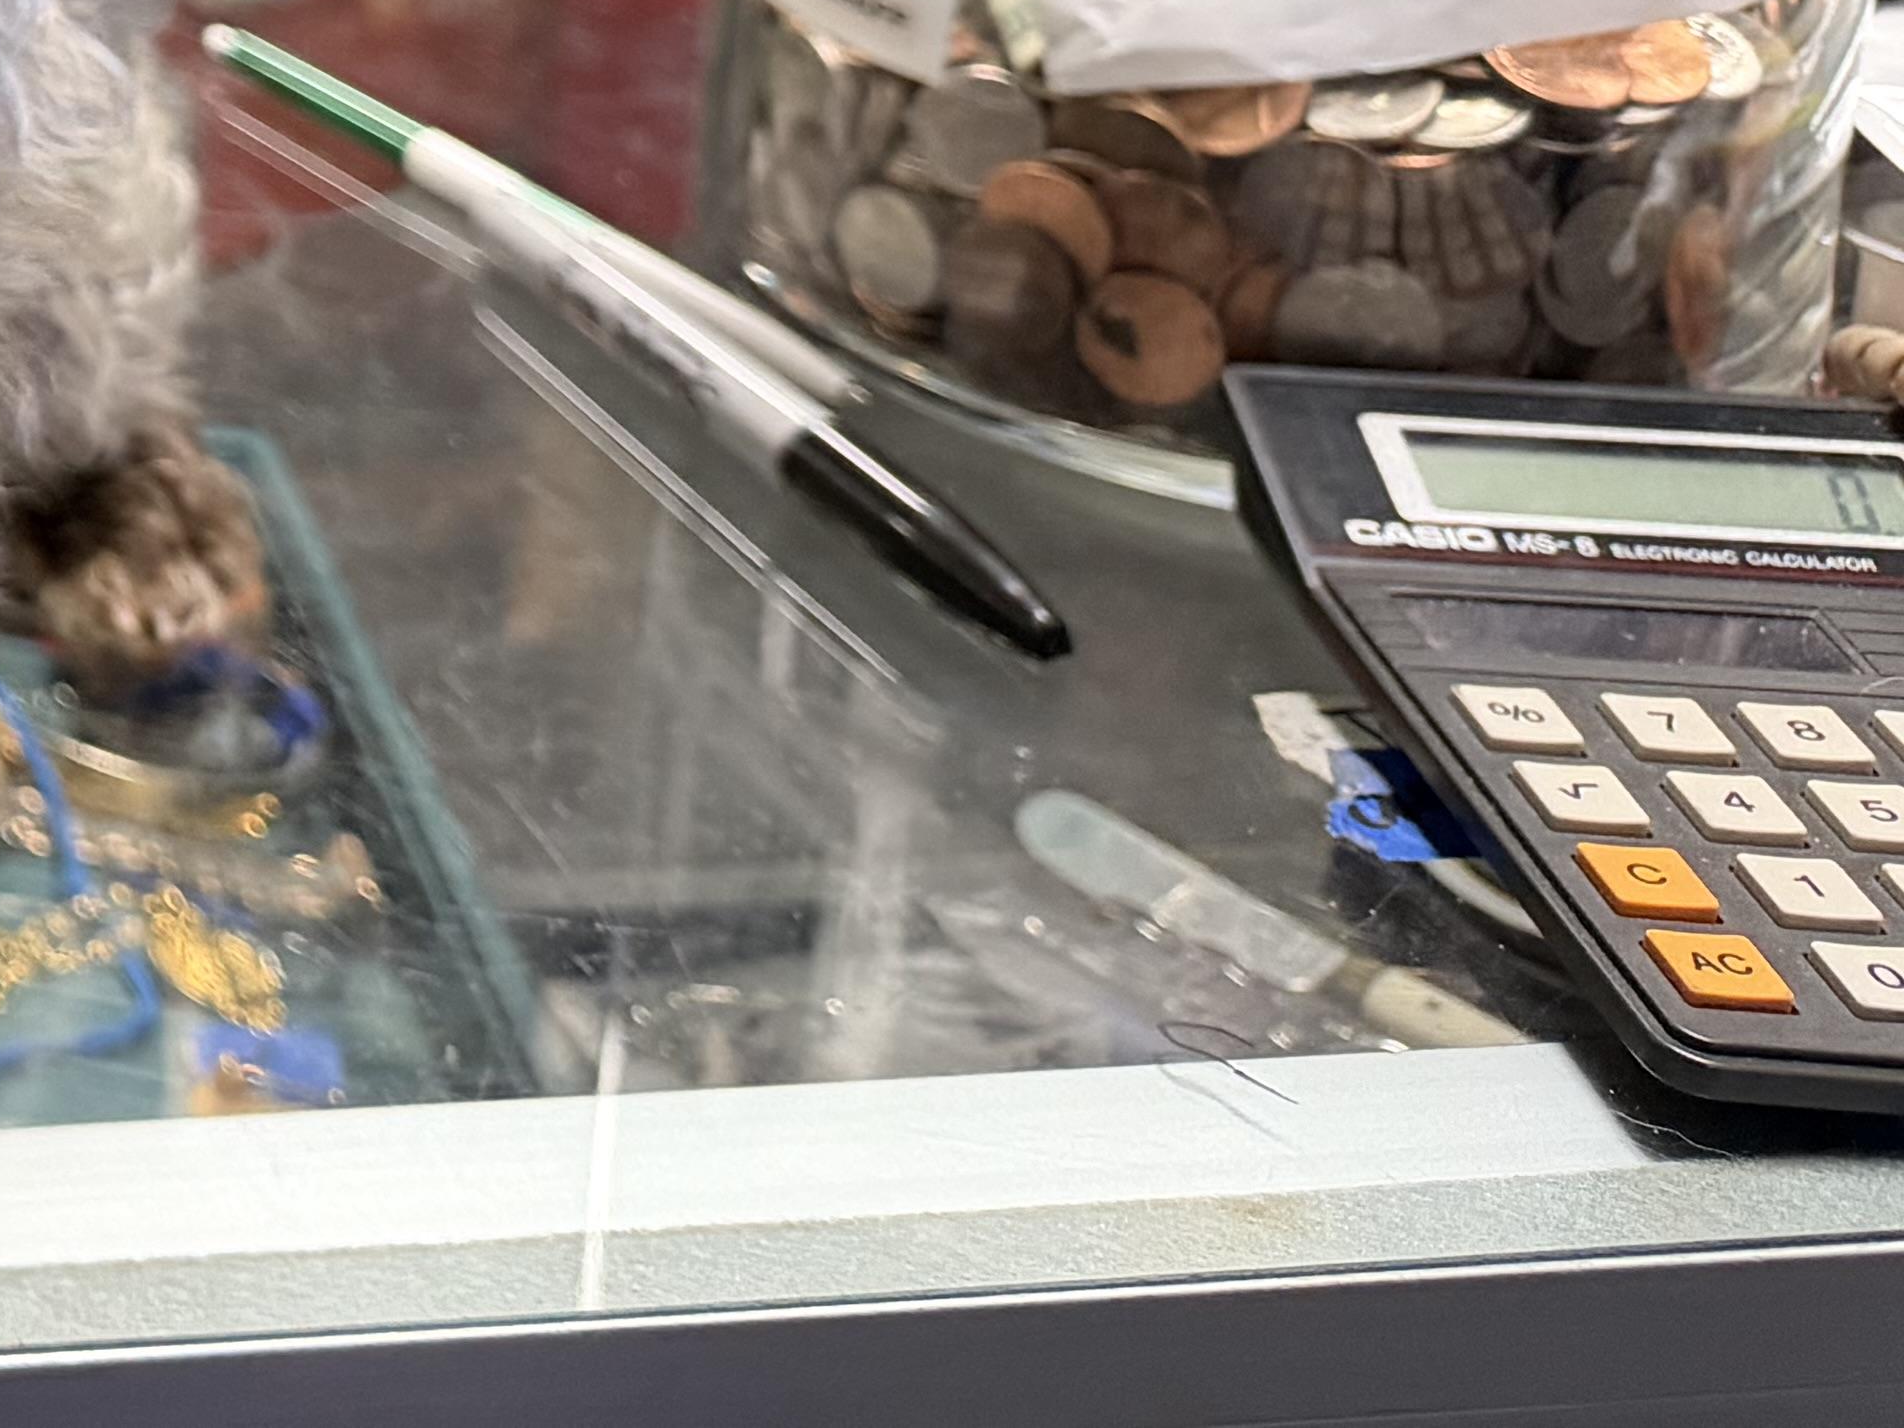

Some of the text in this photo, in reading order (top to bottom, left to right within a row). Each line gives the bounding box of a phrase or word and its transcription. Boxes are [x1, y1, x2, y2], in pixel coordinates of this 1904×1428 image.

[1343, 518, 1499, 552] CASIO
[1609, 542, 1740, 566] ELECTRONIC
[1744, 550, 1878, 574] CALCULATOR
[1646, 711, 1676, 733] 7
[1787, 720, 1826, 742] 8
[1723, 791, 1755, 813] 4
[1860, 800, 1899, 823] 5
[1626, 863, 1668, 887] C
[1793, 875, 1826, 899] 1
[1690, 951, 1754, 976] AC
